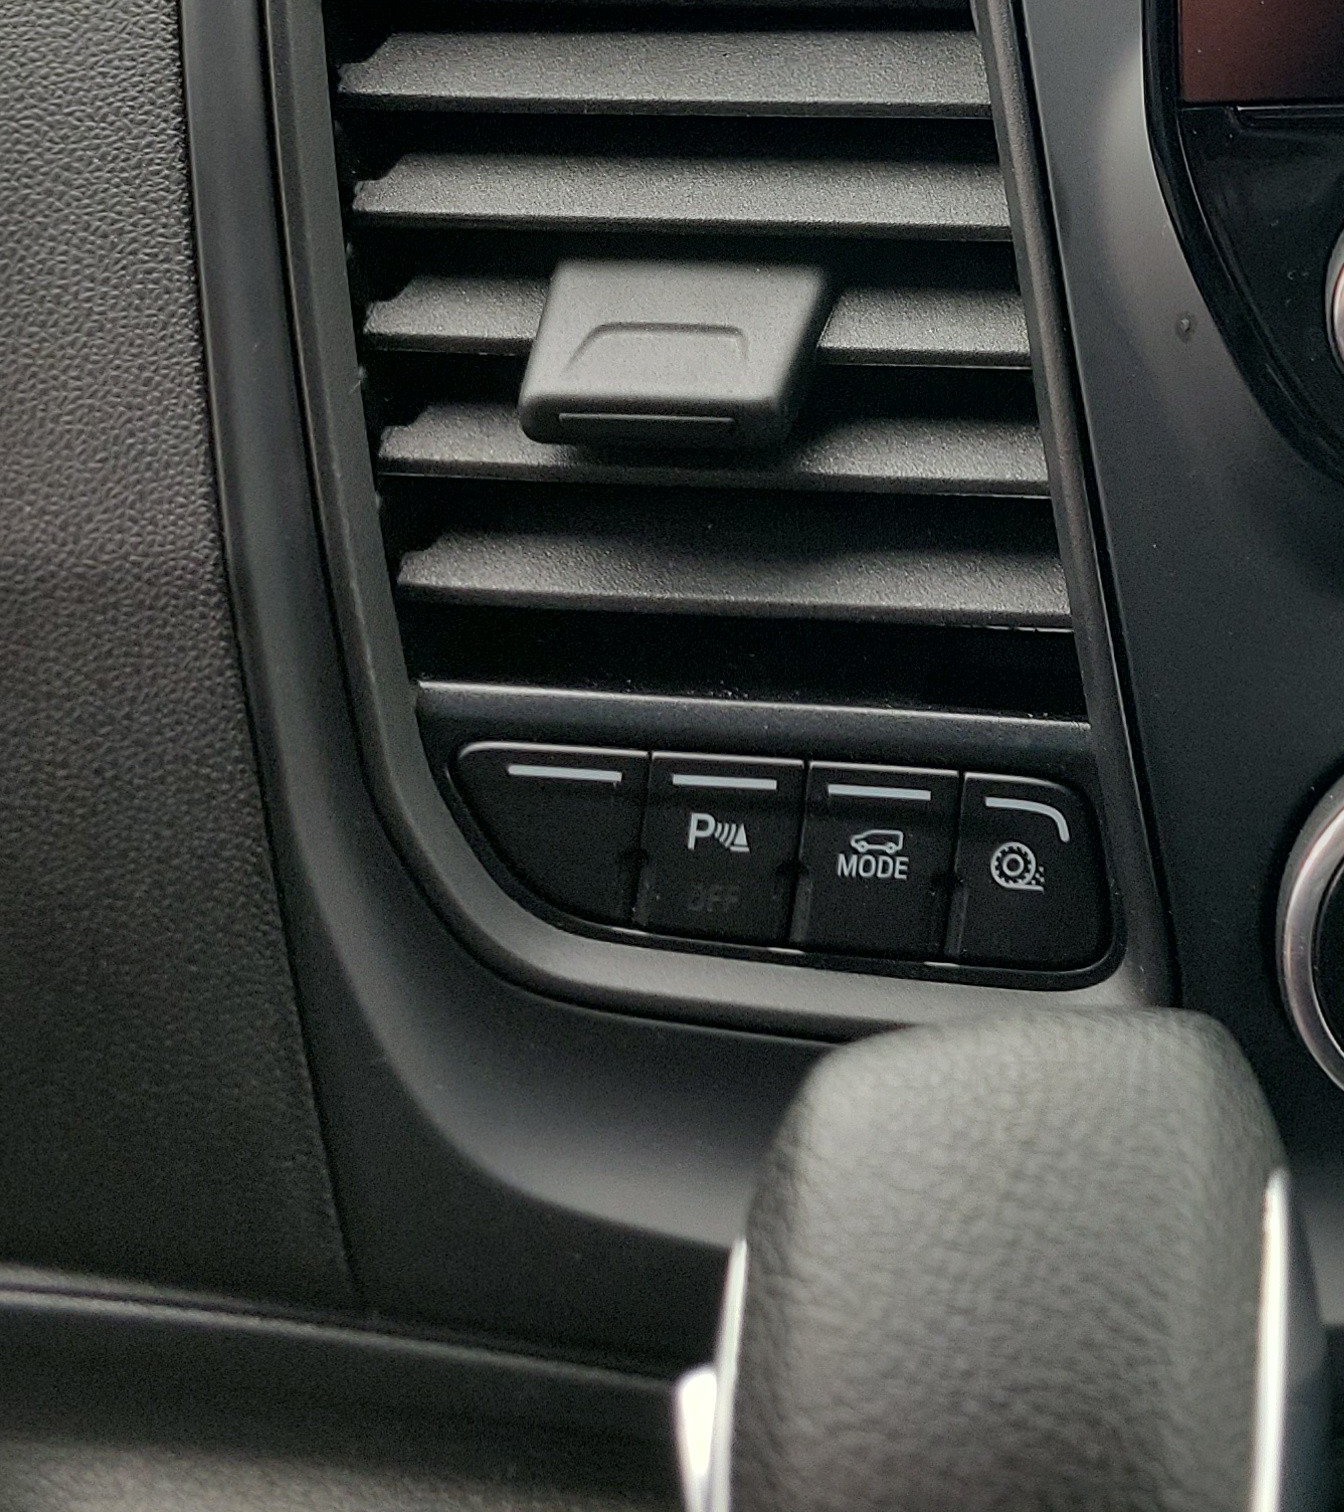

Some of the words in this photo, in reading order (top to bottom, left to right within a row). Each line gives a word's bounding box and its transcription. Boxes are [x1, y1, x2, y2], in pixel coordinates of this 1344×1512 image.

[687, 813, 714, 851] P
[836, 852, 910, 882] MODE
[688, 884, 740, 914] OFF
